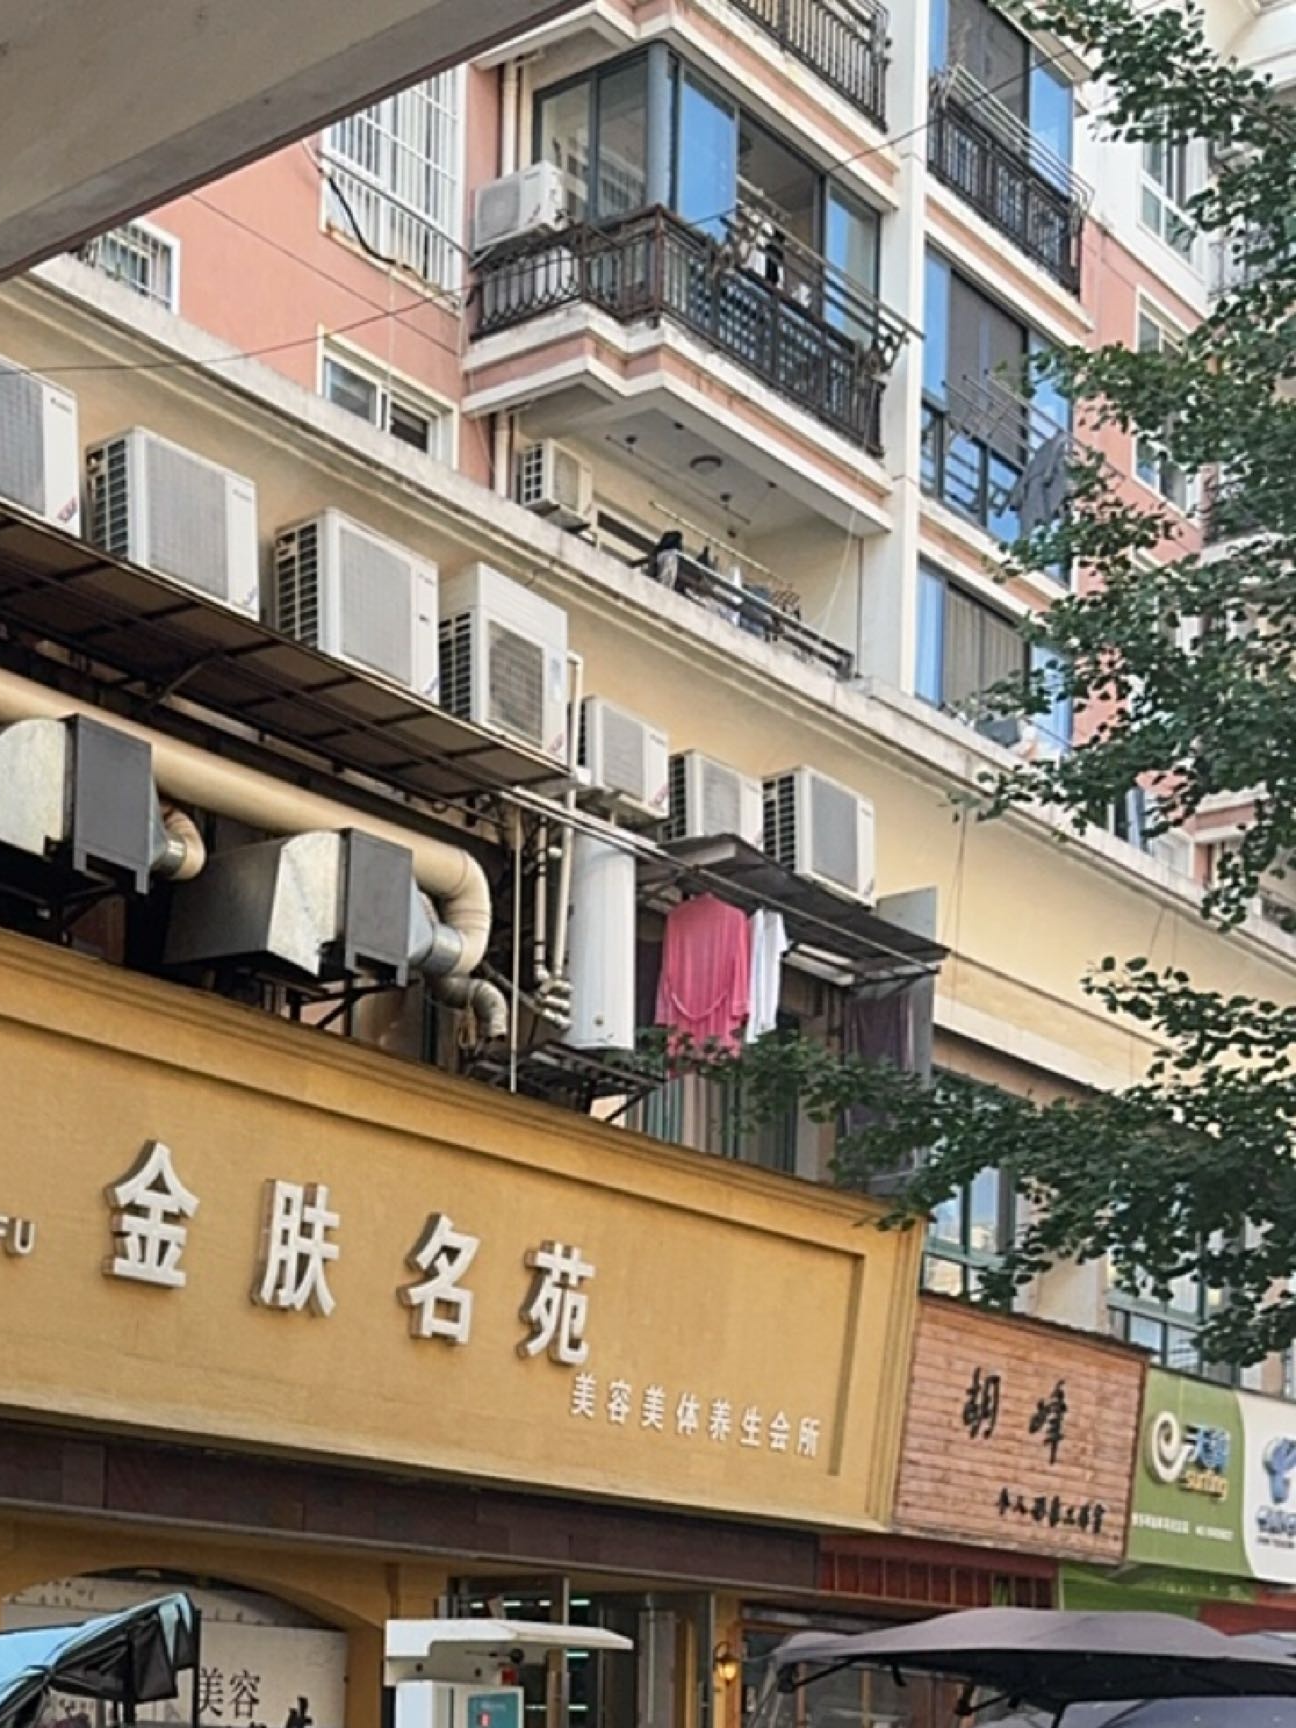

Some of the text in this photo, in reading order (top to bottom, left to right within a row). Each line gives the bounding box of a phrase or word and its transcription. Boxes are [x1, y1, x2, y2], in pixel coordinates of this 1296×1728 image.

[102, 1139, 597, 1366] 金肤名苑
[569, 1372, 822, 1459] 美容美体养生会所
